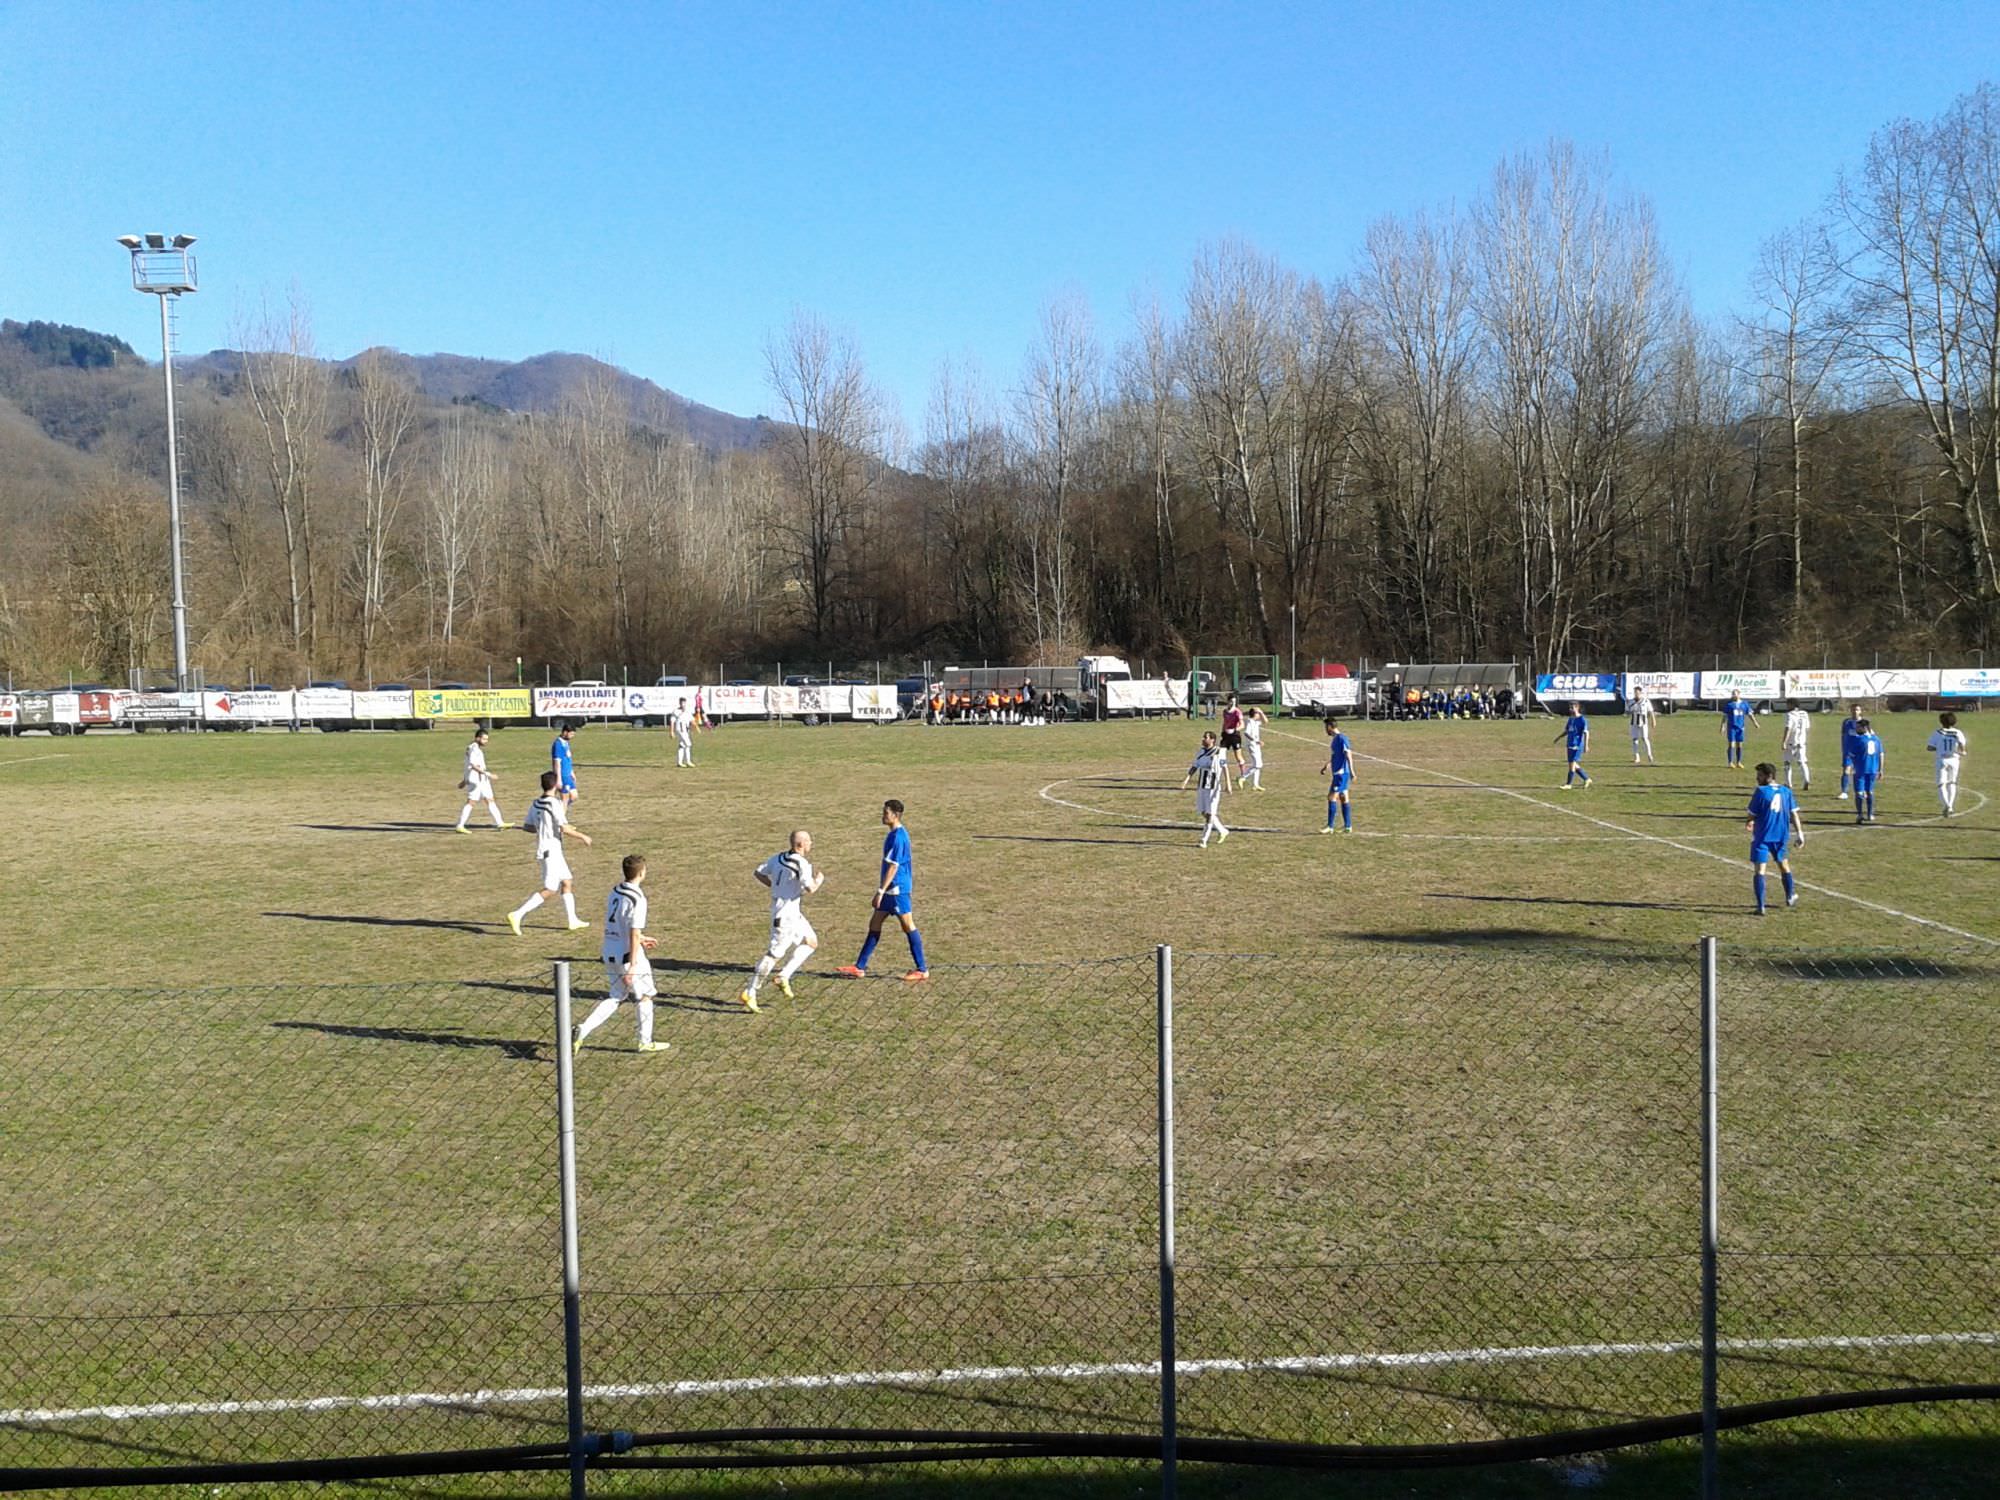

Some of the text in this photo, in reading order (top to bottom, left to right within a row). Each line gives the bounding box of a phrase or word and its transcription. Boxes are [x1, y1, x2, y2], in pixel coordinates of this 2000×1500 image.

[1552, 675, 1598, 689] CLUB
[1633, 674, 1670, 685] QUALITY
[538, 689, 618, 698] IMMOBILIARE
[857, 707, 893, 715] TERRA
[1943, 738, 1953, 751] 11
[1770, 792, 1782, 813] 4
[608, 898, 619, 923] 2
